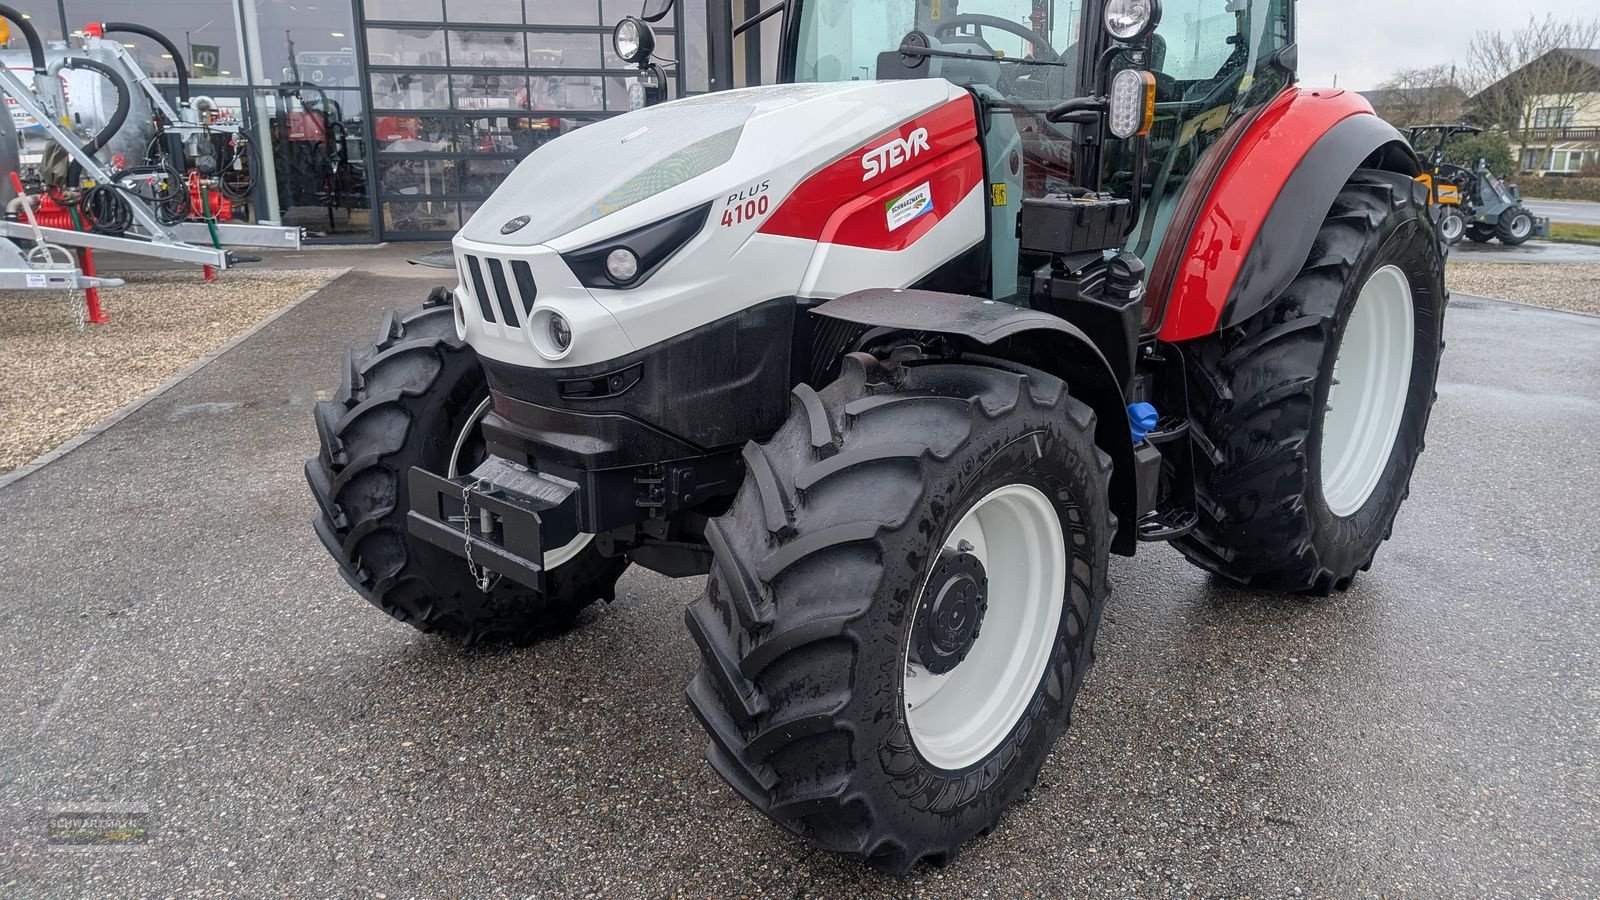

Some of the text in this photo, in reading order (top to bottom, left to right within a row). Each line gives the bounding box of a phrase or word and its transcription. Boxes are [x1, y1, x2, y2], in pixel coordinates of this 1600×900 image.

[862, 127, 931, 182] STEYR
[727, 180, 769, 206] PLUS
[720, 195, 769, 227] 4100
